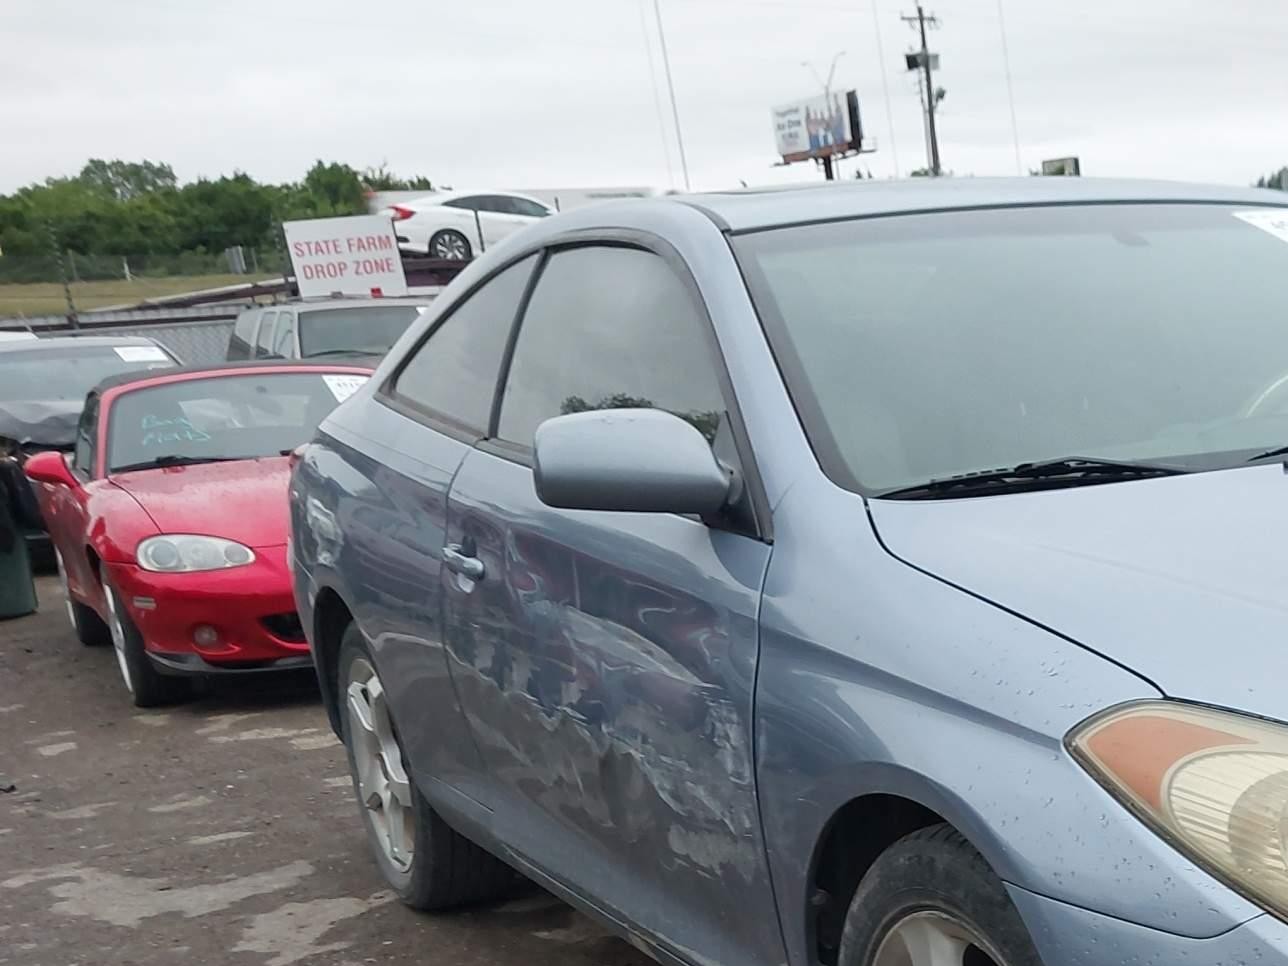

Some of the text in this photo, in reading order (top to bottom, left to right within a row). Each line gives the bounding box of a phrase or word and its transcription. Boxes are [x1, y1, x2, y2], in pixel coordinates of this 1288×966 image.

[293, 234, 393, 258] STATE FARM
[303, 257, 396, 280] DROP ZONE
